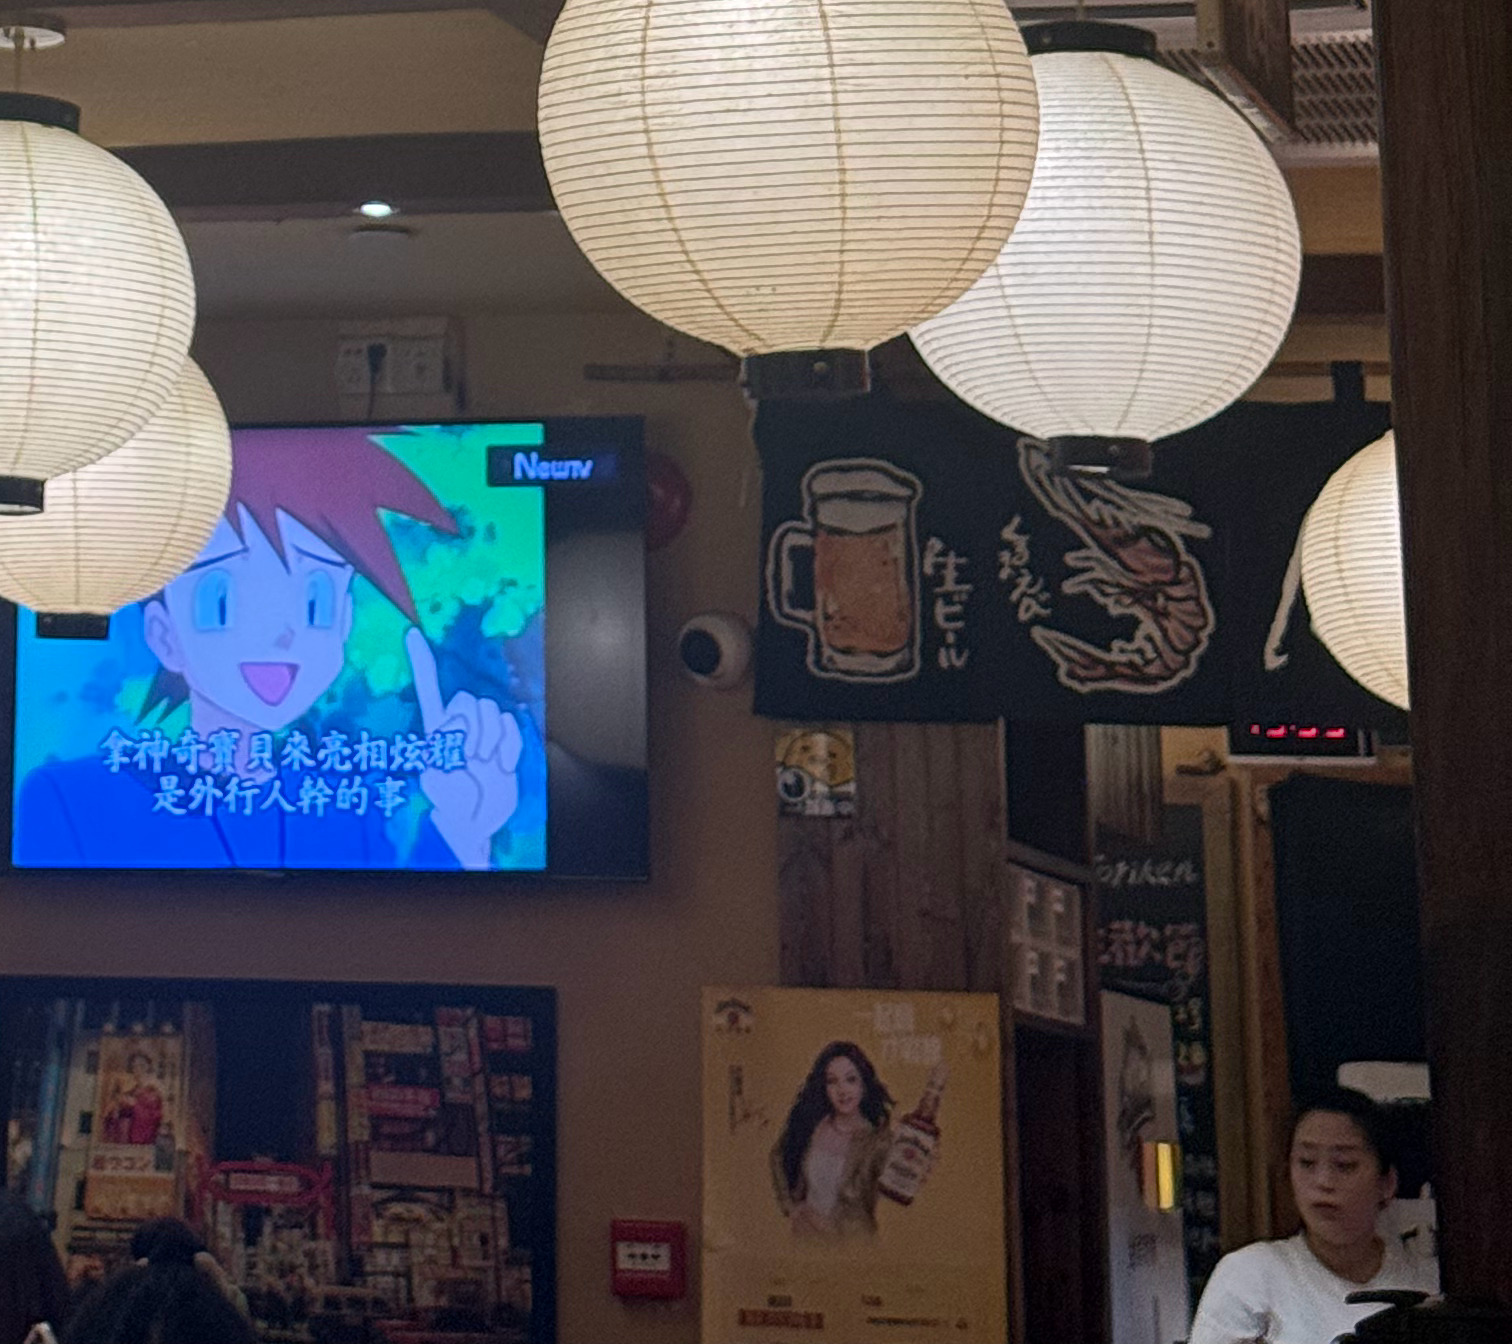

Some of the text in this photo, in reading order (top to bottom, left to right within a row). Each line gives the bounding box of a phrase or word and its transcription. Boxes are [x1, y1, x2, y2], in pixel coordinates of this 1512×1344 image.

[923, 536, 974, 670] 生ビール
[99, 728, 467, 774] 拿神奇寶貝來亮相炫耀
[151, 773, 409, 818] 是外行人幹的事
[1095, 854, 1198, 888] oriken
